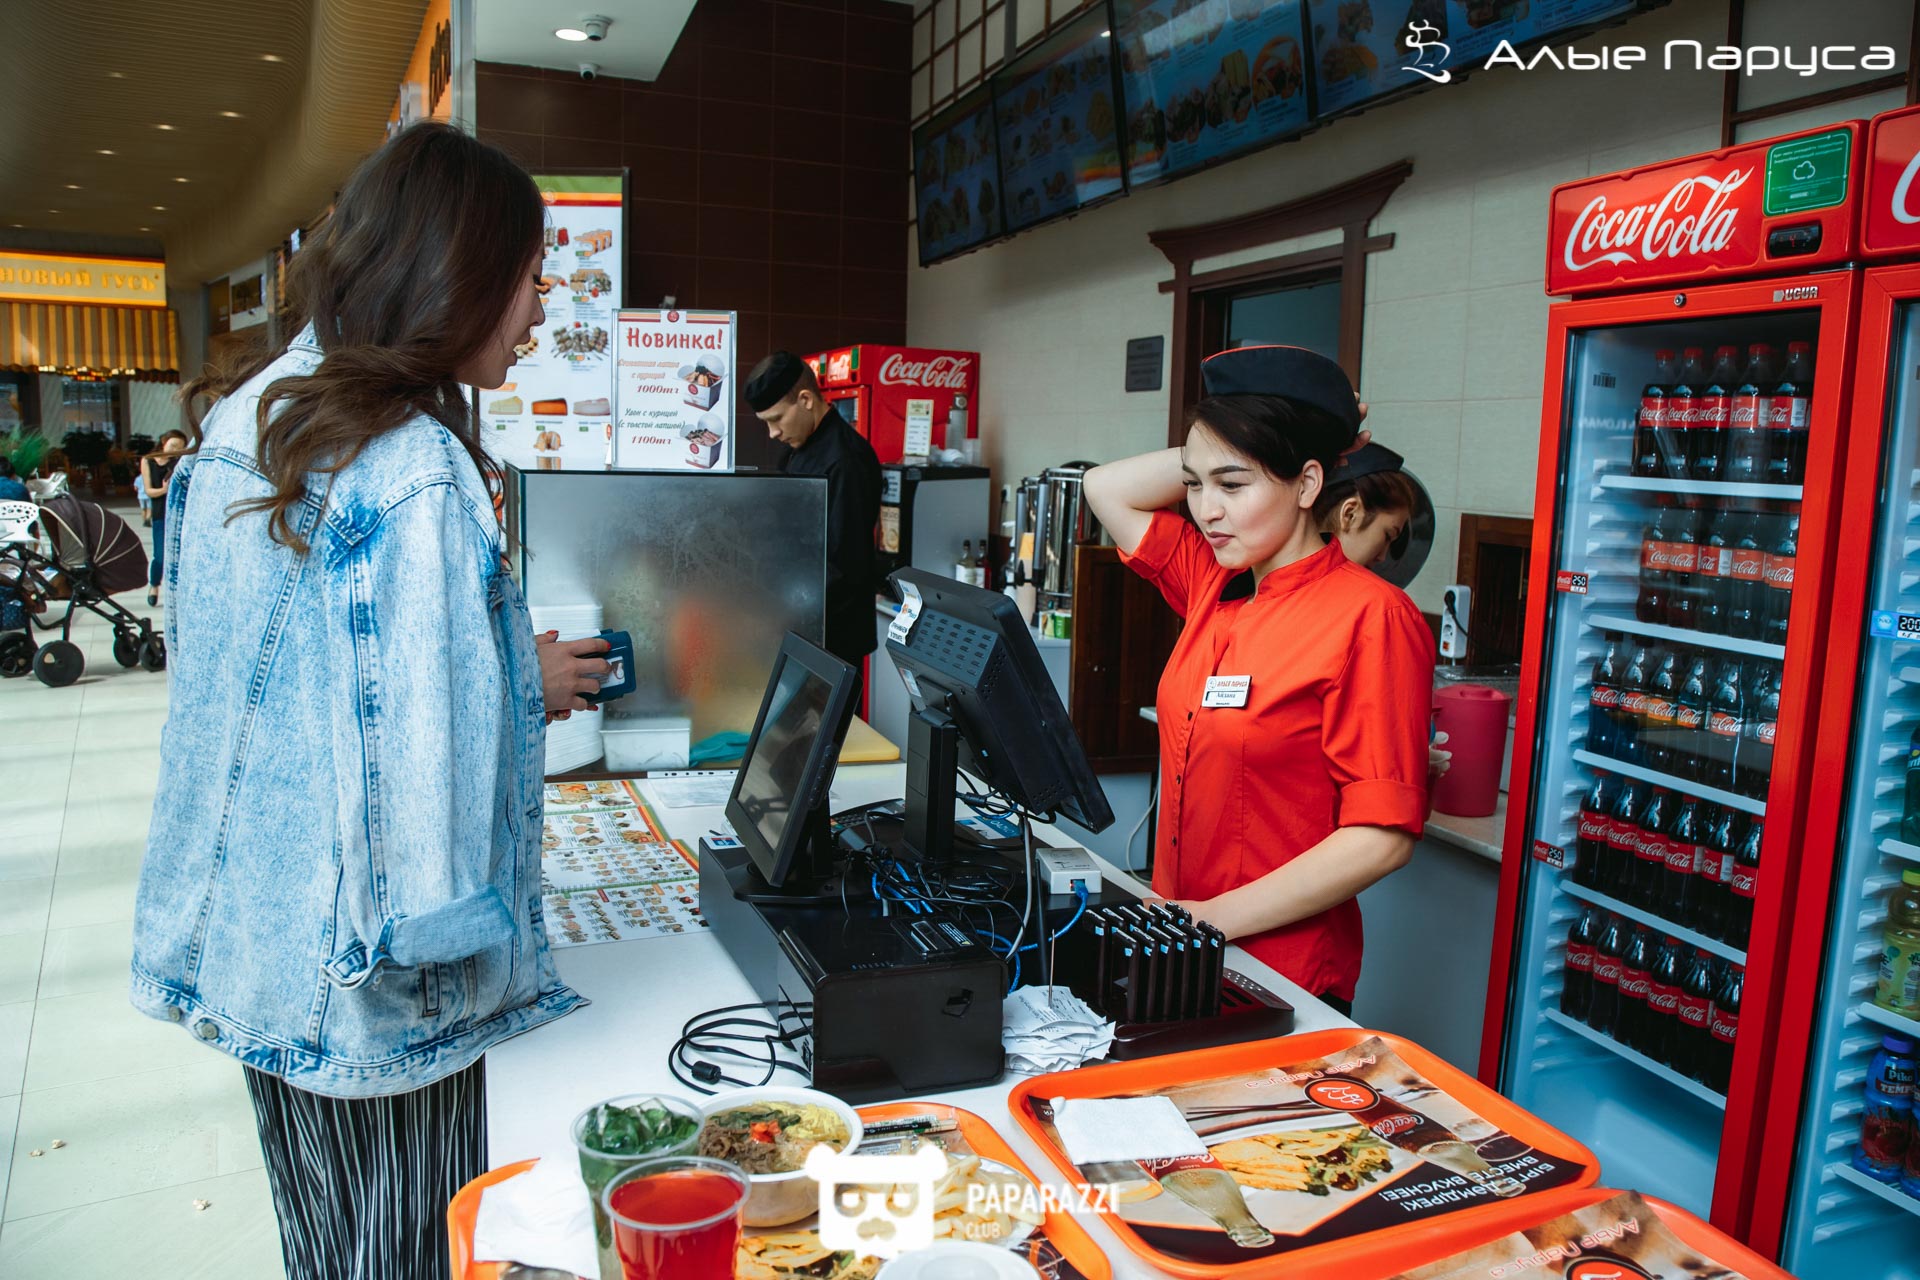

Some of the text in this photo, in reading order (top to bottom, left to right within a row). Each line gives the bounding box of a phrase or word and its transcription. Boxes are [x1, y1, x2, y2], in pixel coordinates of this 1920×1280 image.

[1563, 166, 1755, 271] Coca-Cola
[101, 272, 157, 292] ГУСЬ
[626, 327, 724, 350] Новинка!
[878, 353, 972, 388] Coca-Cola
[1378, 1155, 1540, 1202] ВМЕСТЕ ВКУСНЕЕ!
[1580, 1216, 1640, 1249] Алые
